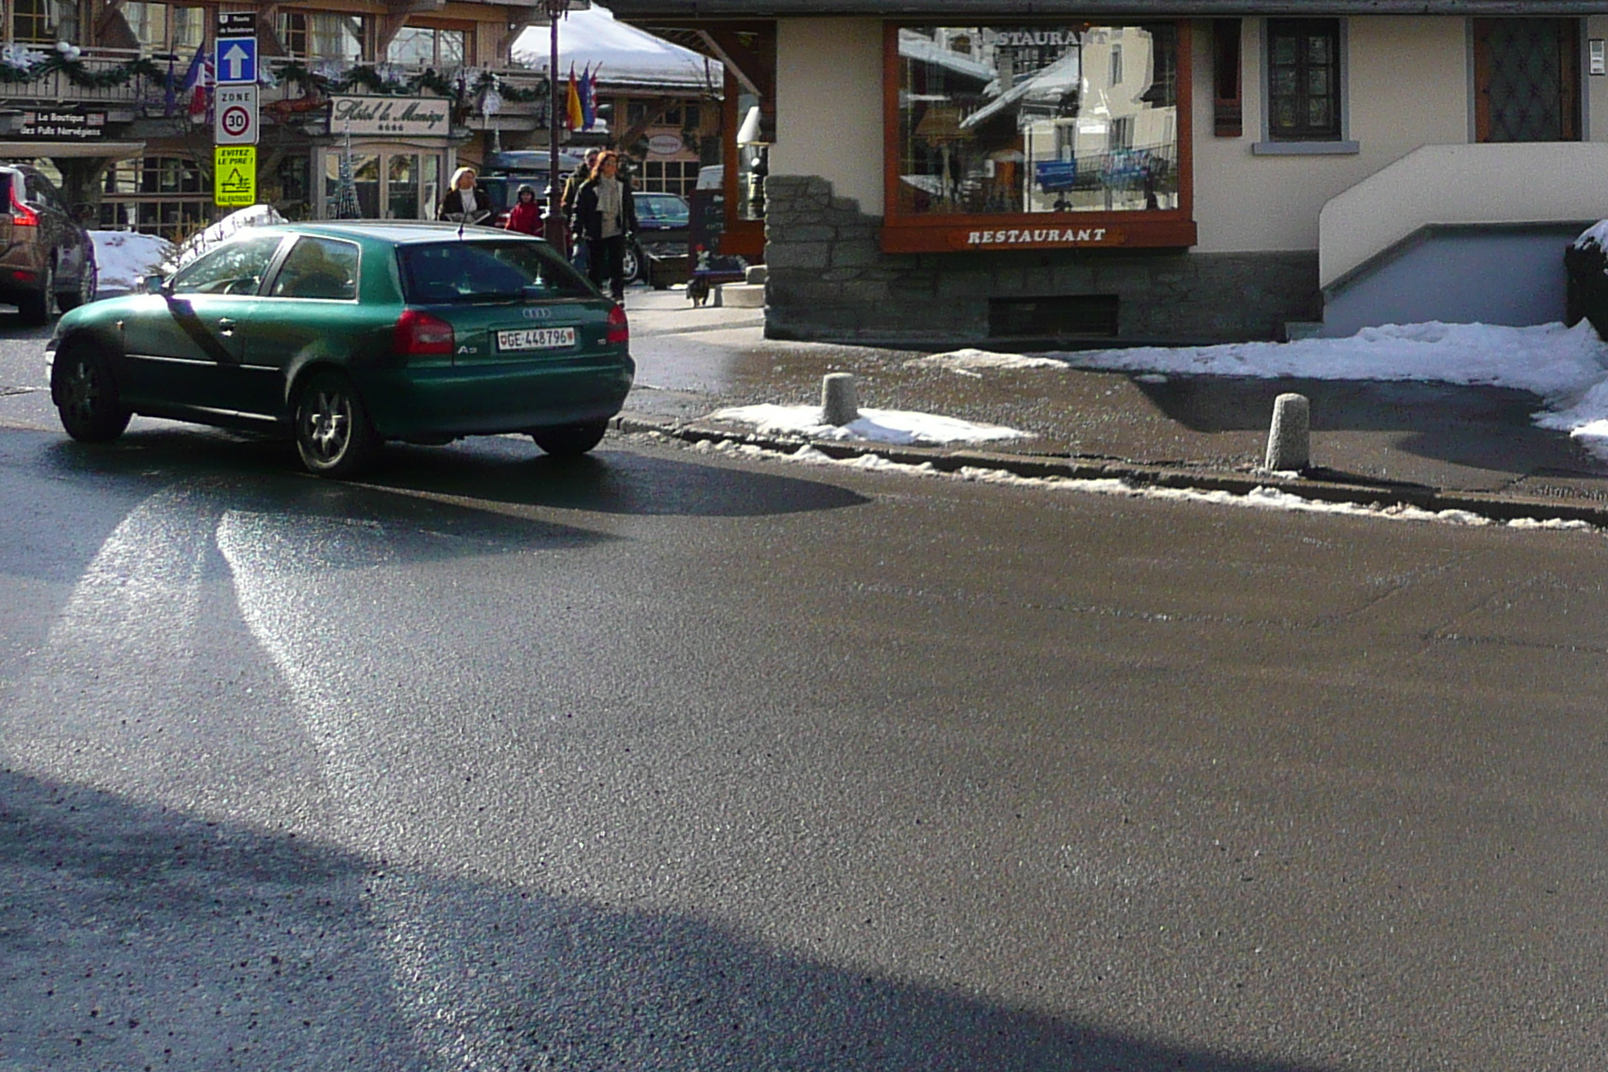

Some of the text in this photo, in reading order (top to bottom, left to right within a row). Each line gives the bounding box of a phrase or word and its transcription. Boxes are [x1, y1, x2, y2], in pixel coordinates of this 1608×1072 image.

[221, 93, 250, 102] ZONE
[51, 112, 85, 123] Boutique
[228, 115, 244, 127] 30
[20, 127, 35, 135] des
[967, 228, 1106, 244] RESTAURANT
